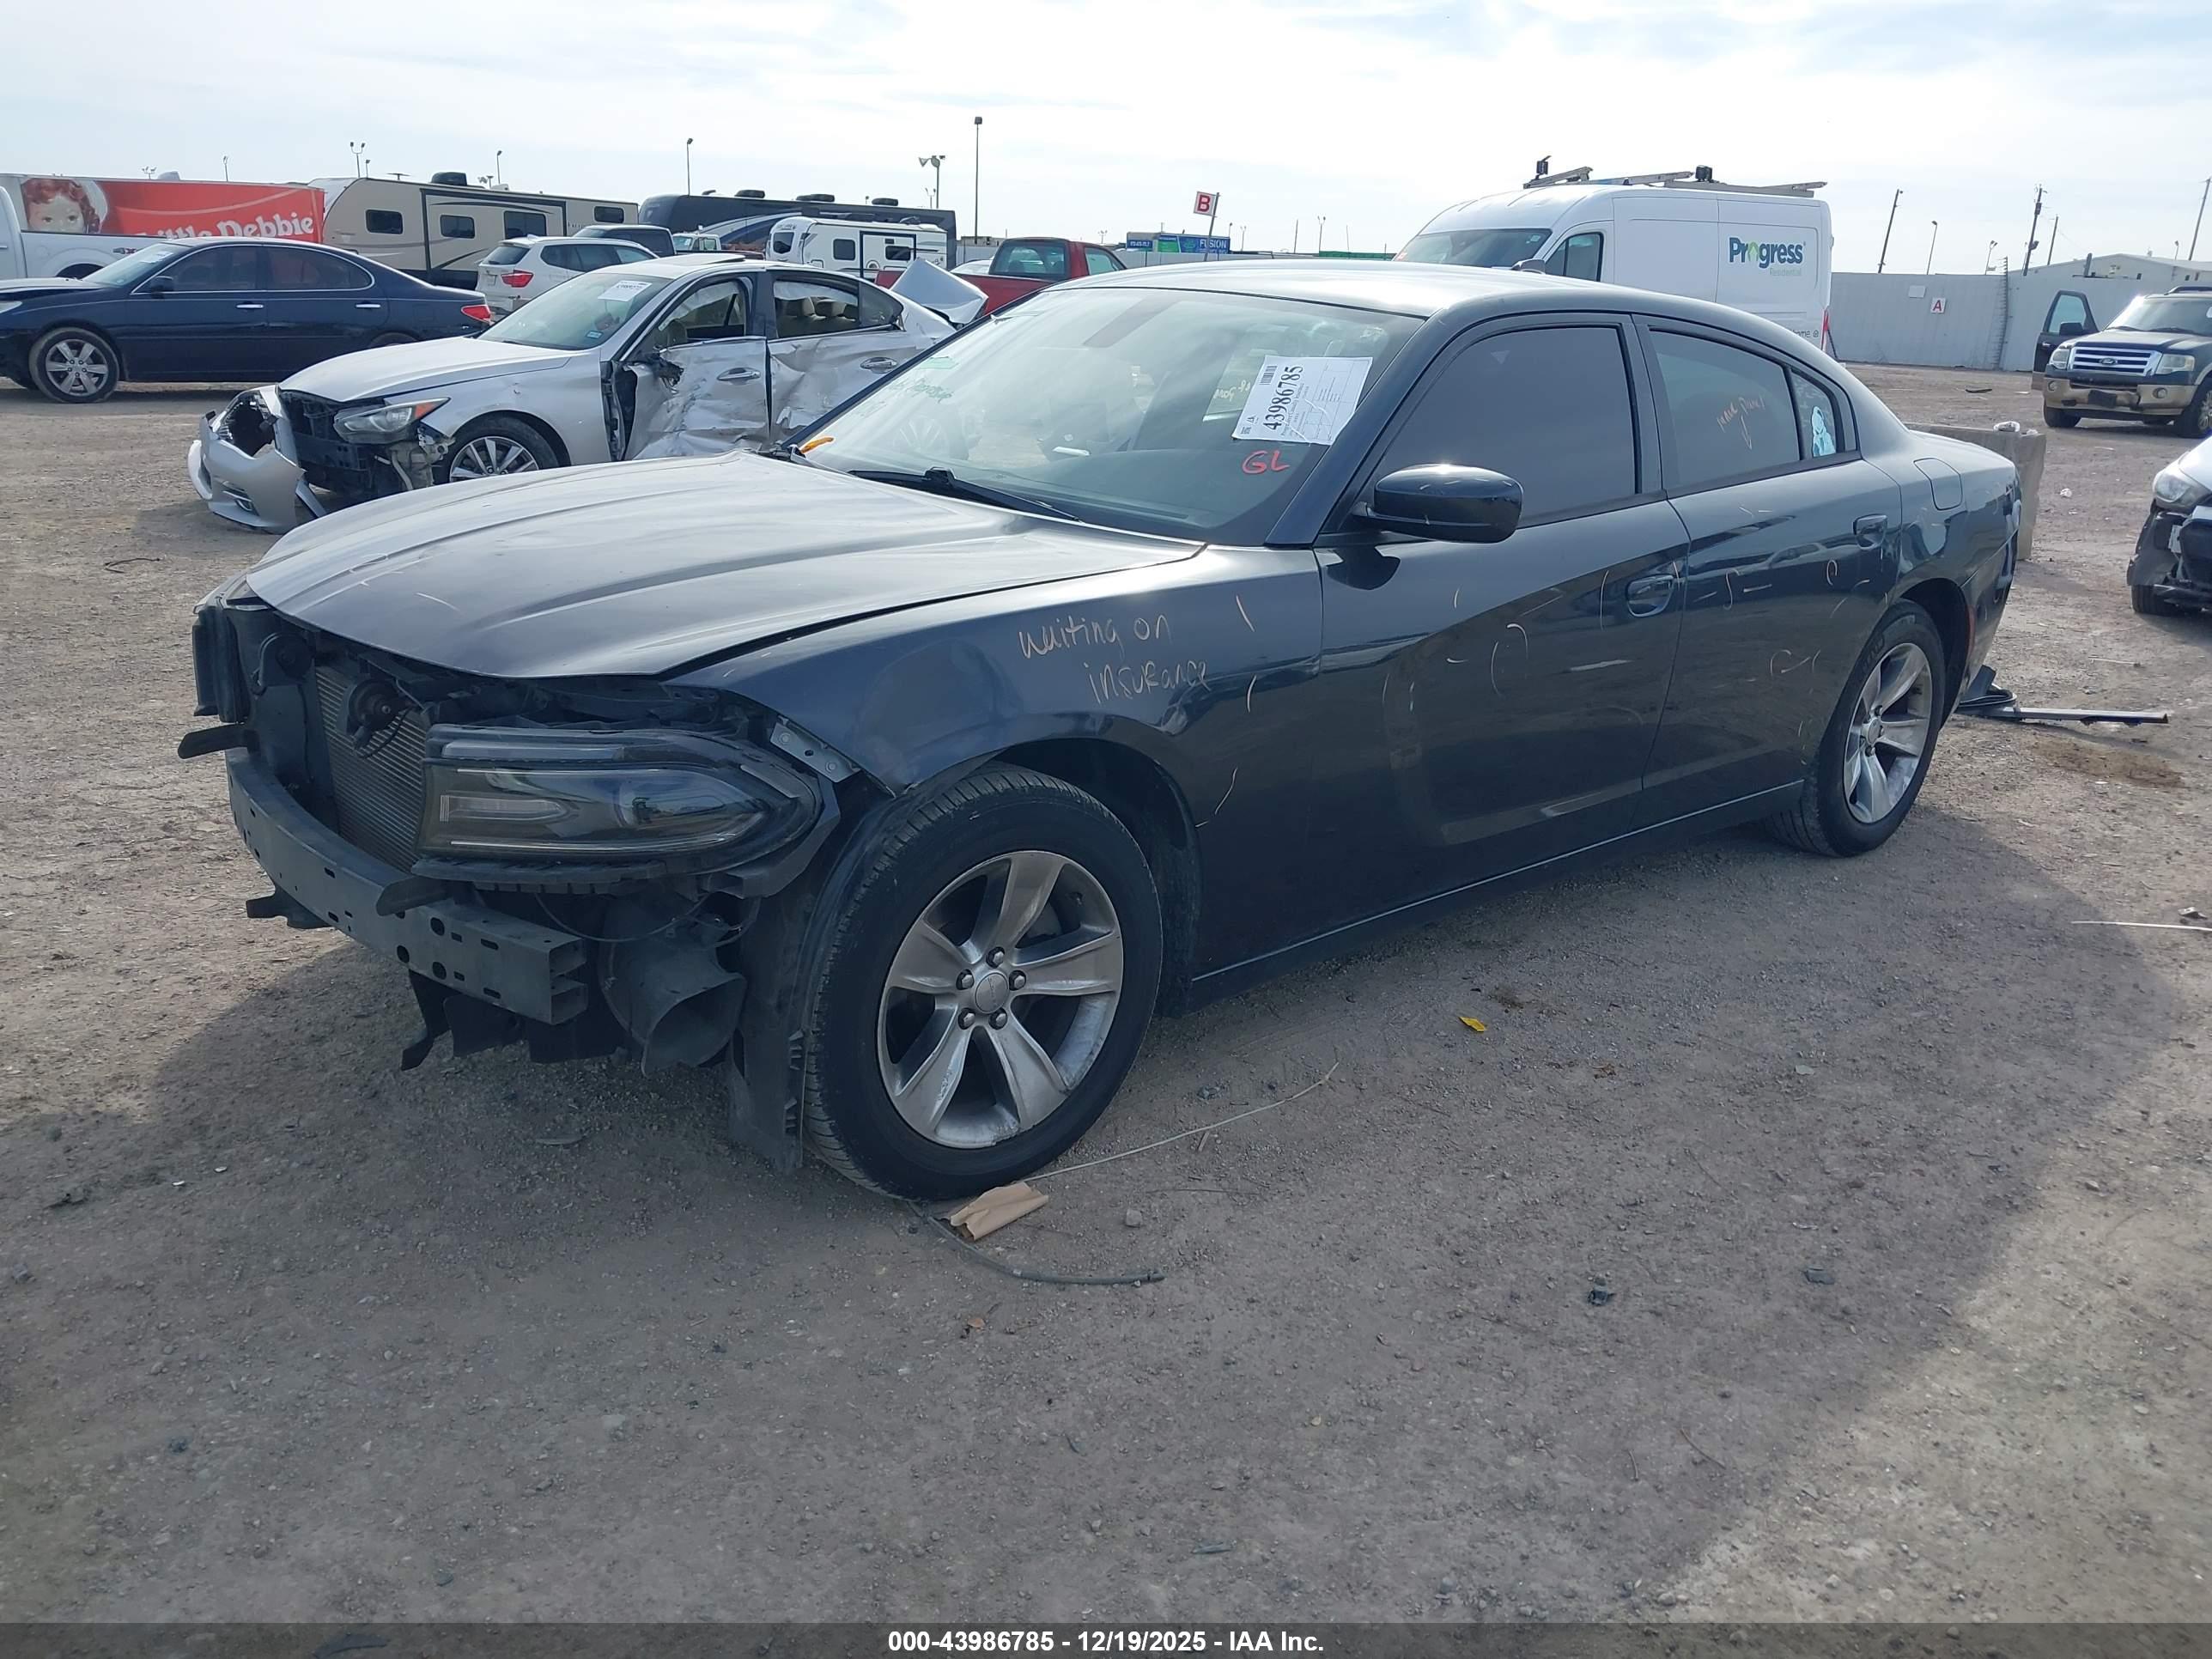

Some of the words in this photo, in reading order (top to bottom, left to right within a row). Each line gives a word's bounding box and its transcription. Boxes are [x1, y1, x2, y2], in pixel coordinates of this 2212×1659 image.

[1197, 194, 1211, 212] B
[216, 212, 314, 238] Debbie
[1729, 237, 1803, 269] Progress
[1932, 300, 1942, 312] A
[1263, 366, 1304, 430] 43986785
[1242, 450, 1291, 475] GL
[1133, 614, 1174, 646] on
